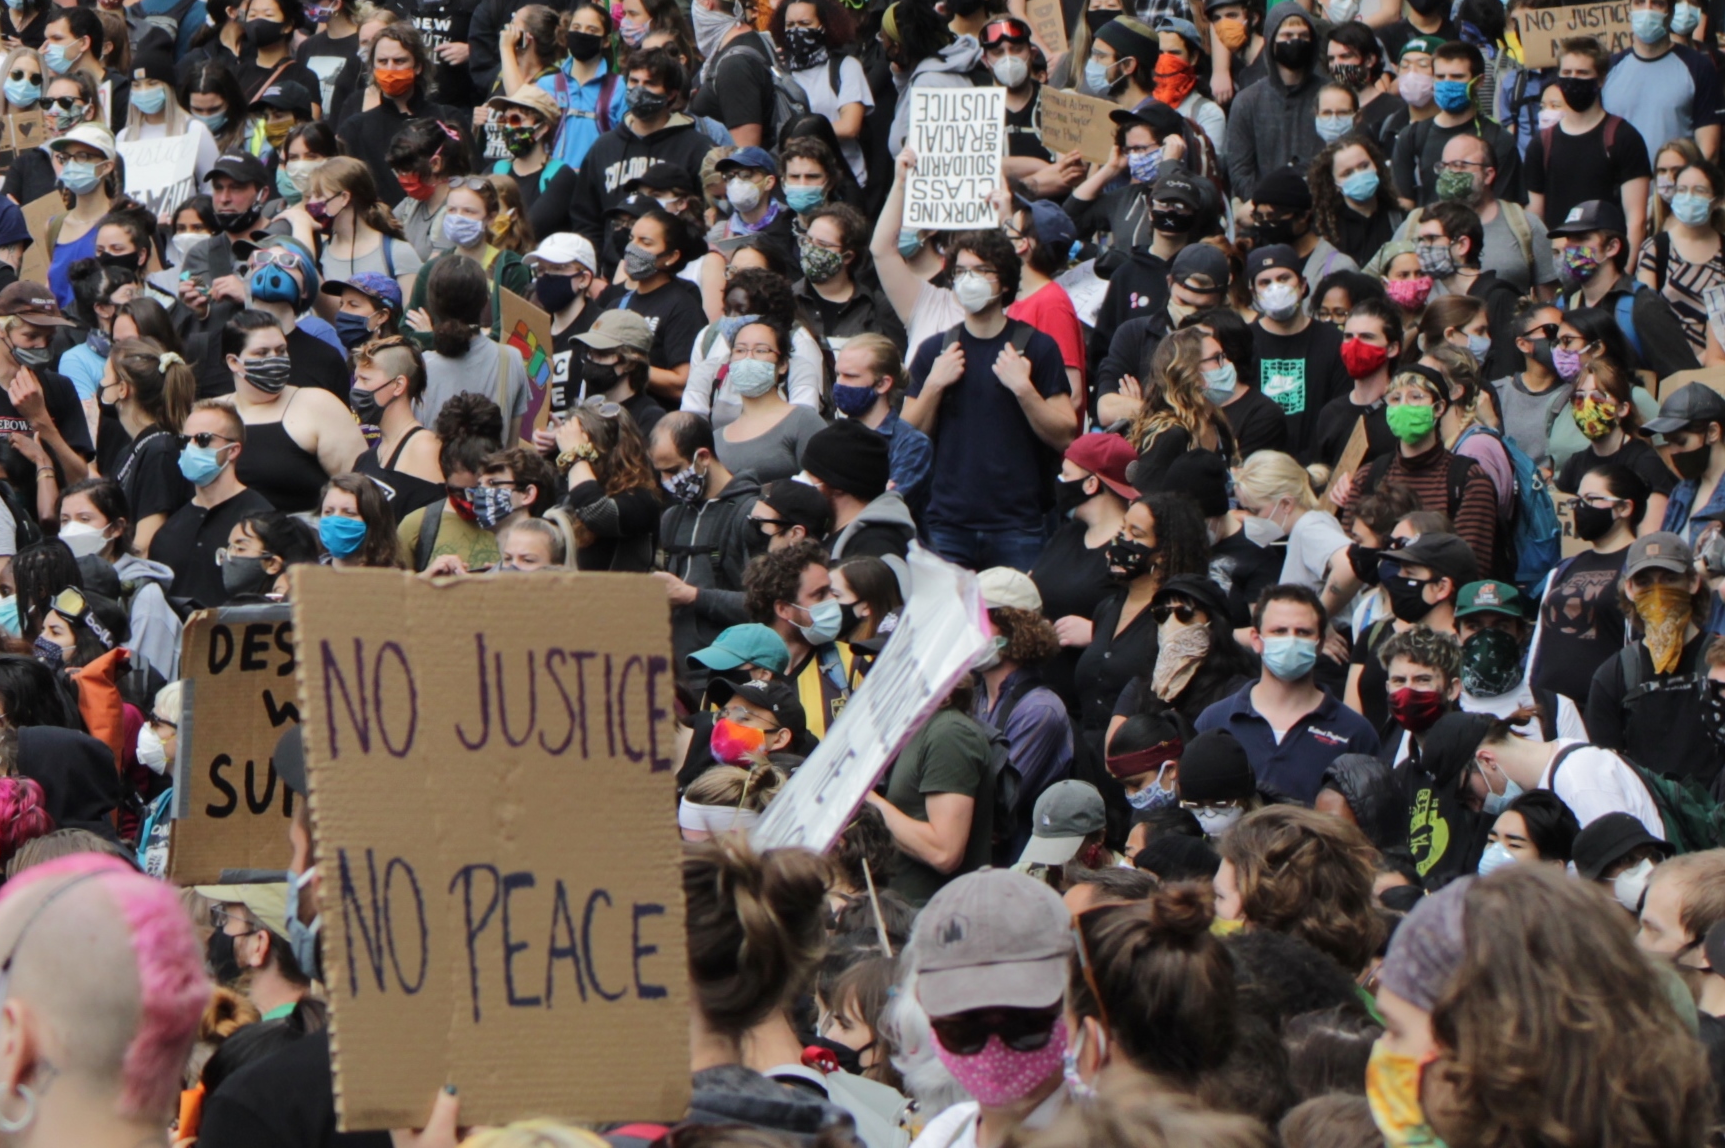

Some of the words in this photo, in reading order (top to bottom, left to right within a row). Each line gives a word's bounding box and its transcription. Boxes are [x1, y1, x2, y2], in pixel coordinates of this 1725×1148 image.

[1524, 12, 1556, 32] NO
[916, 92, 1001, 123] JUSTICE
[915, 123, 985, 154] RACIAL
[984, 122, 998, 153] FOR
[910, 153, 996, 177] SOLIDARITY
[911, 177, 995, 201] CLASS
[909, 201, 994, 224] WORKING
[321, 637, 419, 759] NO
[454, 632, 674, 773] JUSTICE
[336, 848, 429, 998] NO
[449, 862, 670, 1024] PEACE
